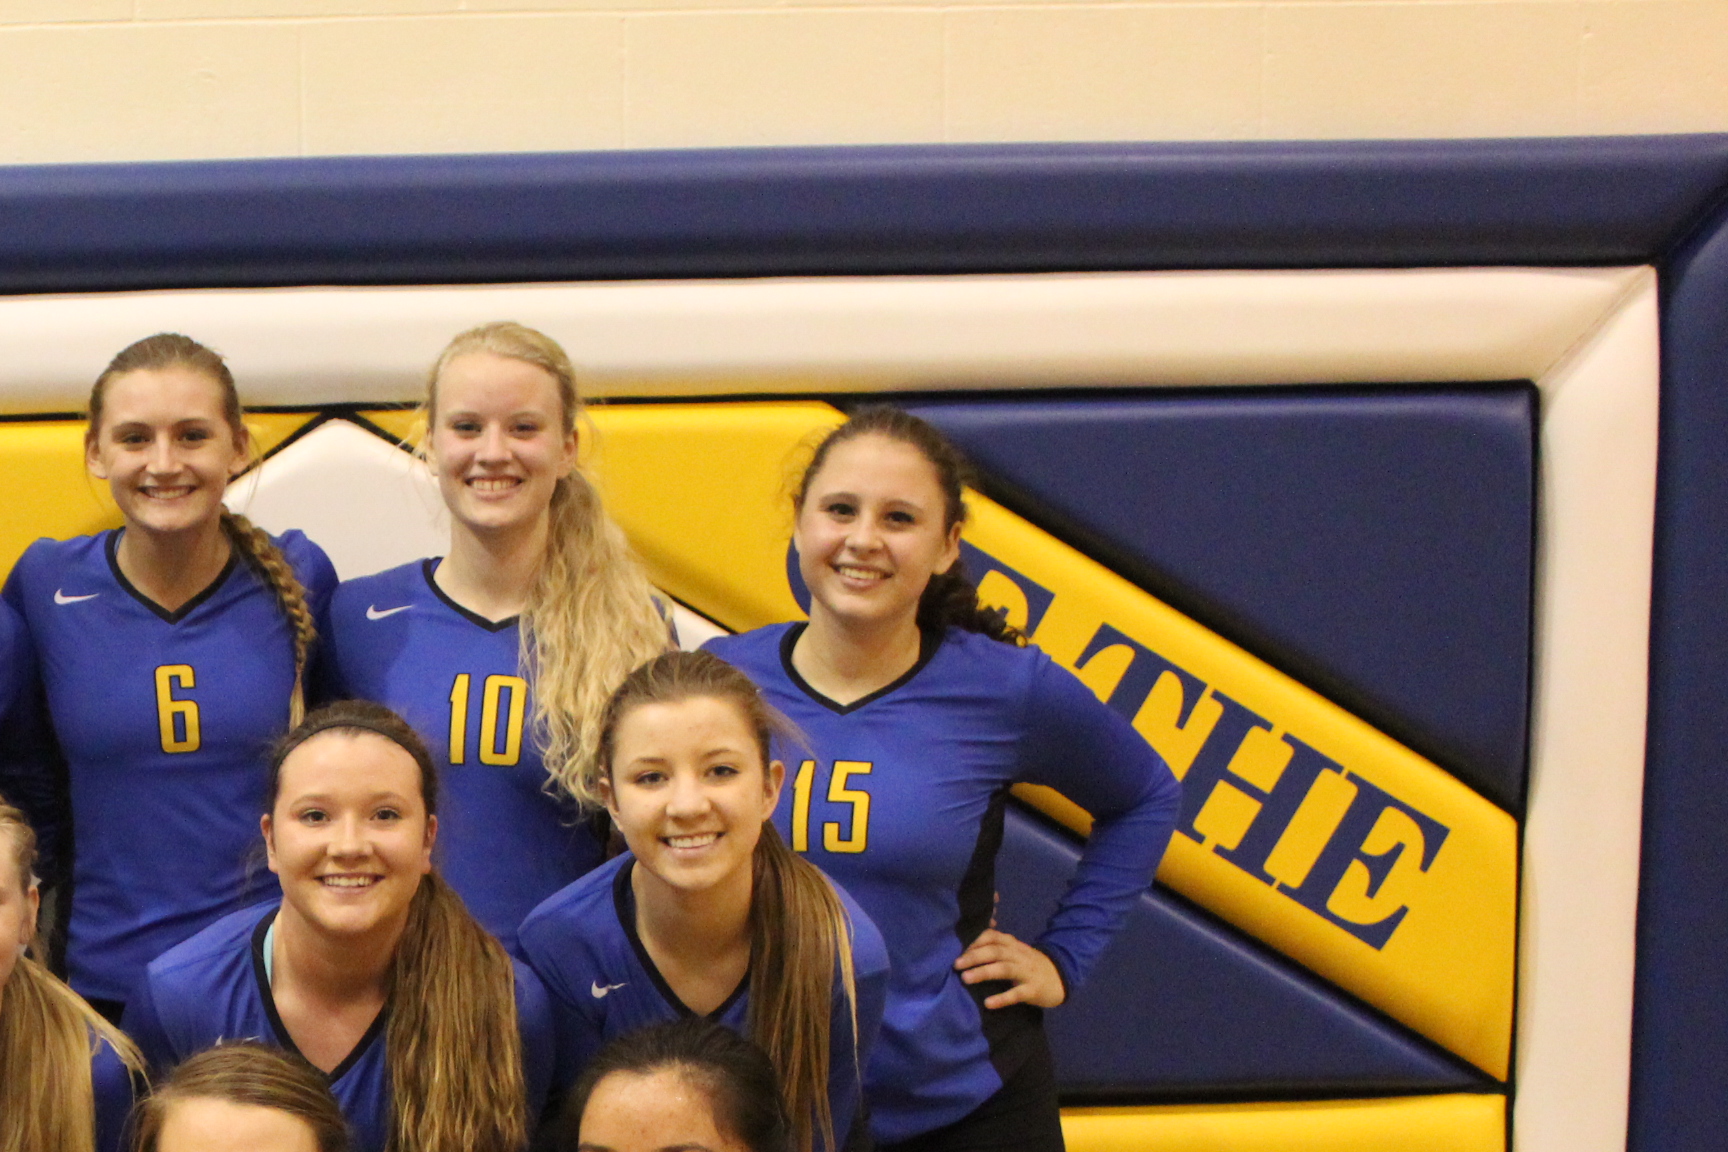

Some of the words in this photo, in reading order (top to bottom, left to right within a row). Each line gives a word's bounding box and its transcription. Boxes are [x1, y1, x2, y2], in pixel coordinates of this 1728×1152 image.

[154, 664, 202, 753] 6
[449, 673, 527, 767] 10
[791, 760, 873, 853] 15
[1074, 622, 1451, 951] THE
